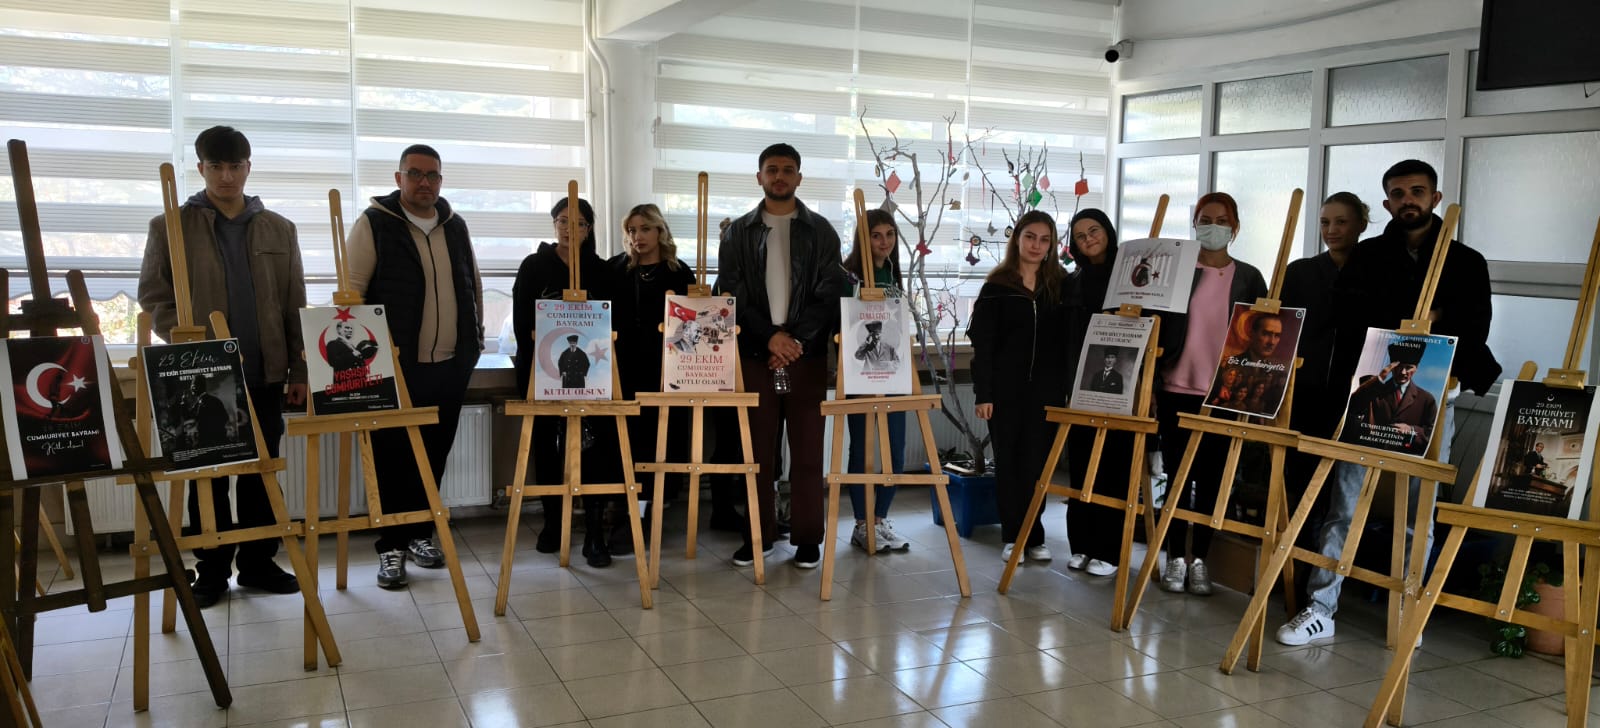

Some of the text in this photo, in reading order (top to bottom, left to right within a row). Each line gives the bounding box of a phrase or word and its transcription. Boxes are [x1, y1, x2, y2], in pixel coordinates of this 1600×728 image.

[679, 355, 692, 363] 29
[544, 388, 571, 396] KUTLU
[1519, 407, 1577, 419] CUMHURİYET
[1517, 415, 1574, 429] BAYRAMI
